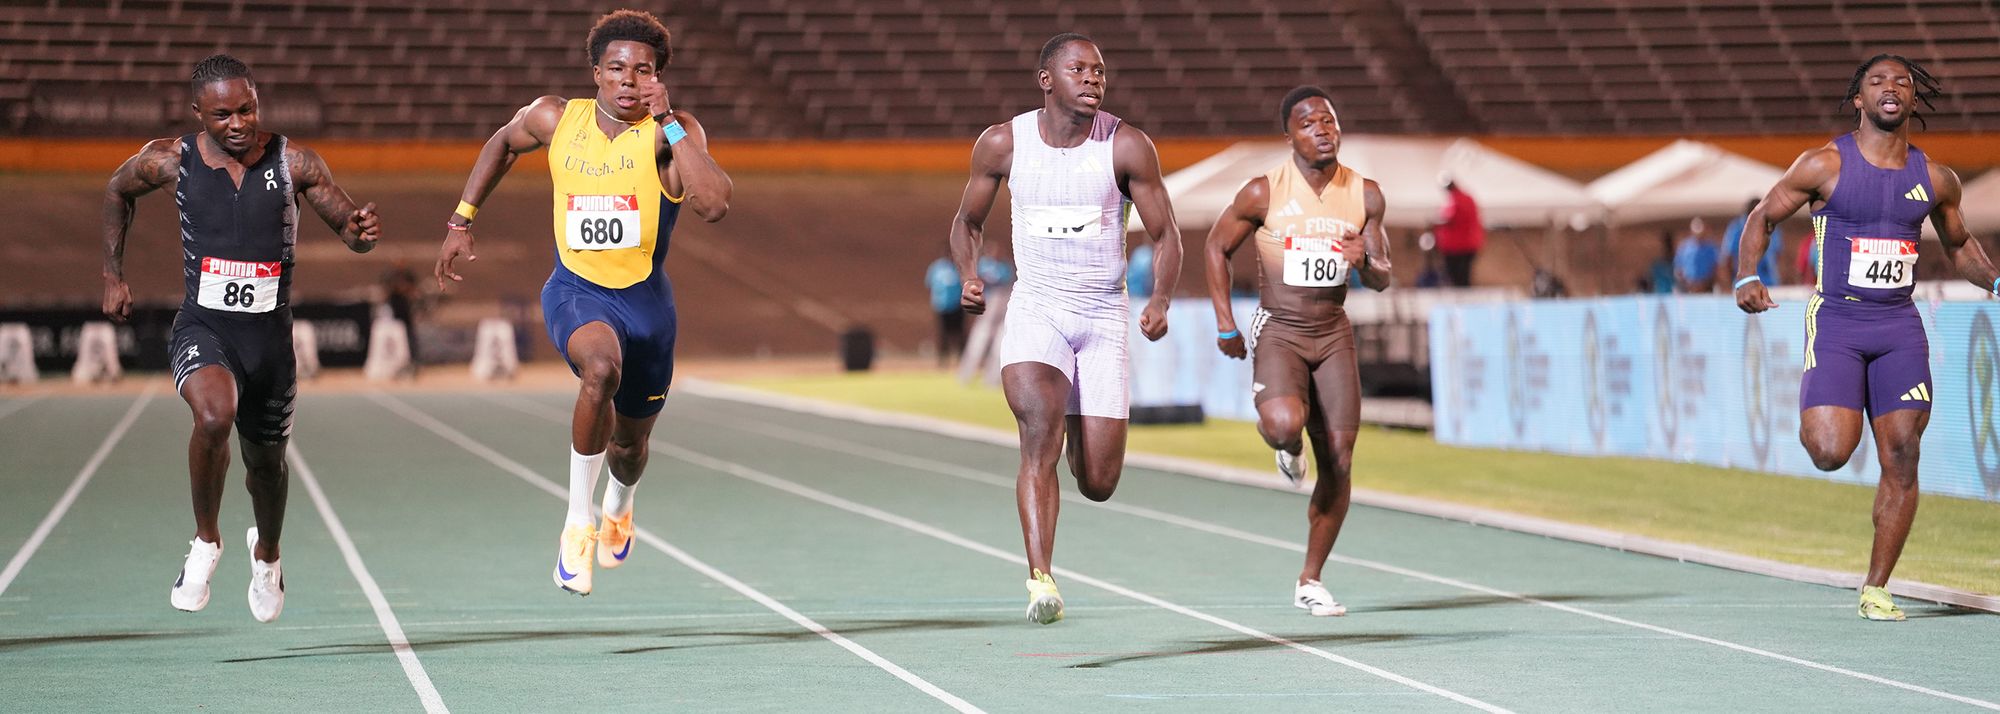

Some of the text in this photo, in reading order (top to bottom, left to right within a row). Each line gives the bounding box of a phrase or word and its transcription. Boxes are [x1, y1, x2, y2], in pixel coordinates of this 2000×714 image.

[573, 195, 614, 211] PUMA
[580, 217, 623, 244] 680
[1859, 239, 1900, 255] PUMA
[209, 258, 256, 277] PUMA
[1301, 257, 1337, 281] 180
[1865, 260, 1904, 284] 443
[223, 281, 255, 308] 86
